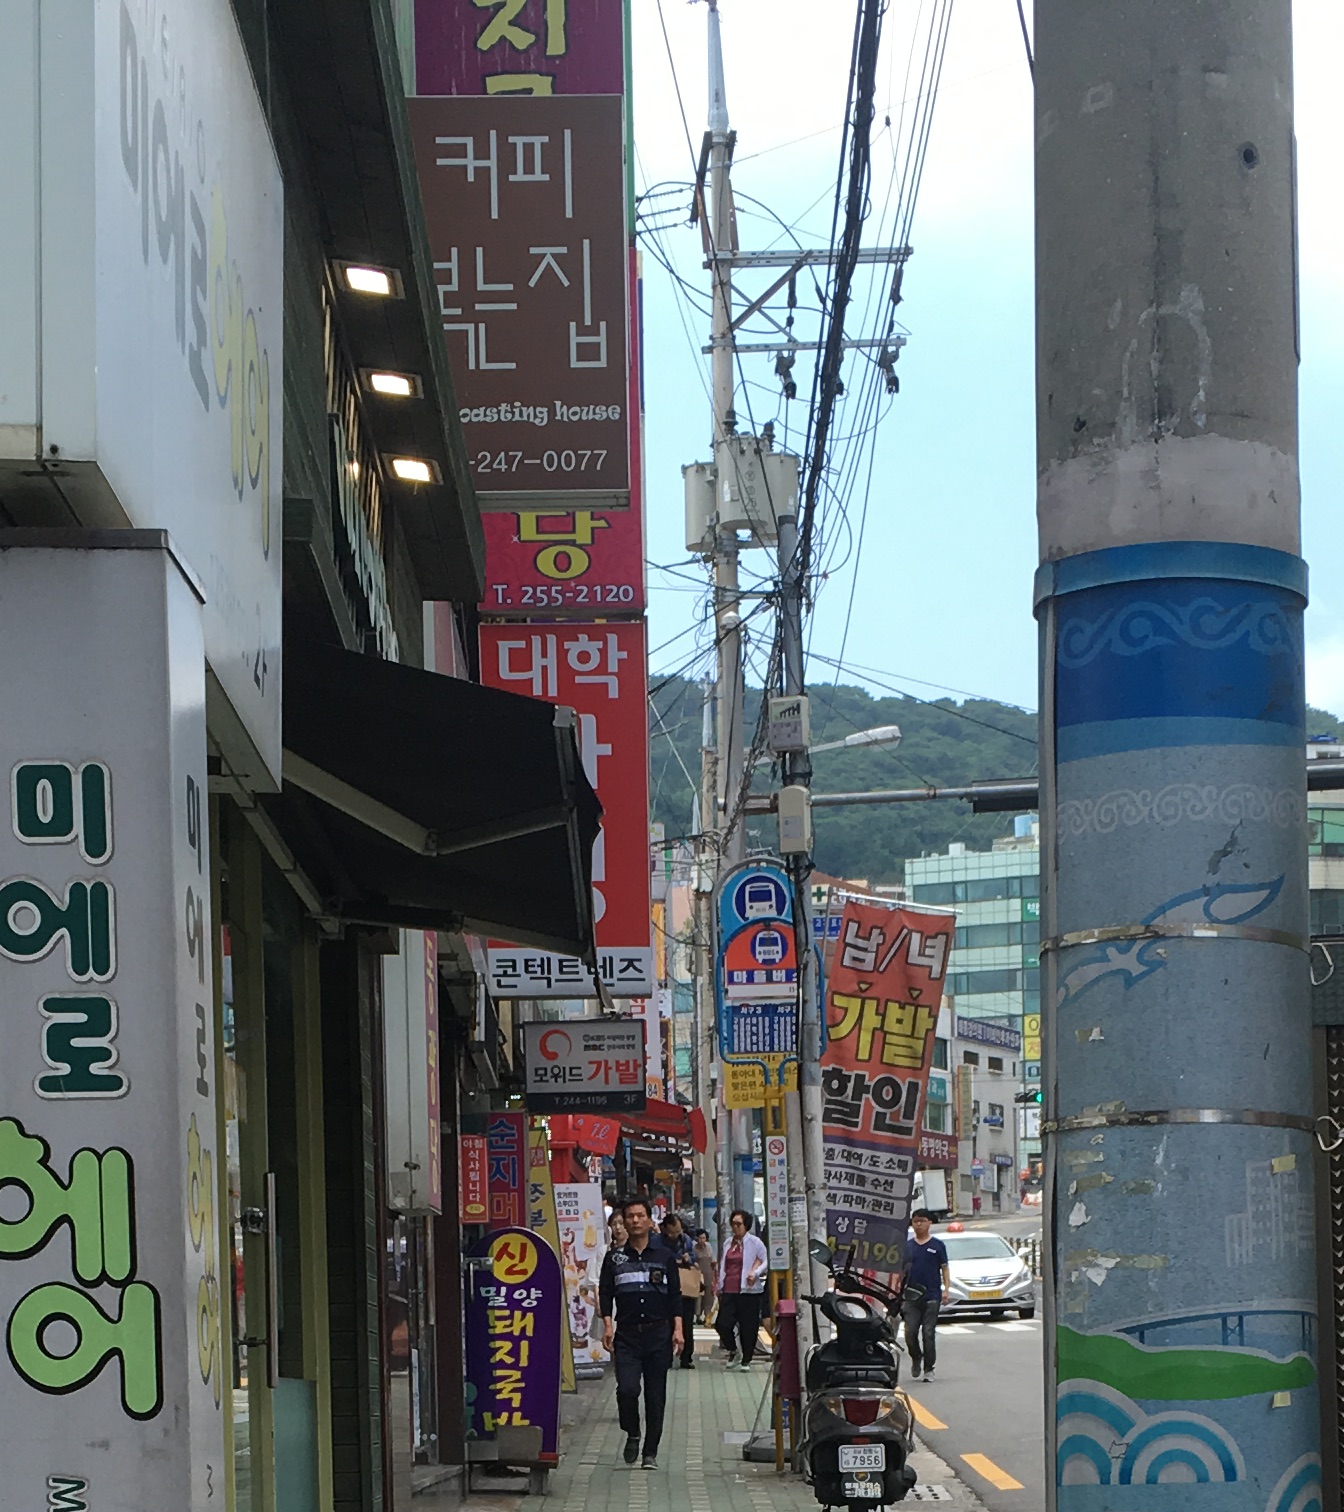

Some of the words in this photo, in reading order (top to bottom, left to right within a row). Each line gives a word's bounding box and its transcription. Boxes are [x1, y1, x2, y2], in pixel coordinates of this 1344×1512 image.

[435, 129, 573, 219] 커피
[555, 400, 622, 422] house
[493, 585, 512, 604] T.
[521, 584, 635, 606] 255-2120
[497, 633, 628, 699] 대학
[841, 920, 950, 981] 남/녀
[827, 991, 936, 1071] 가발
[587, 1058, 642, 1085] 가발
[821, 1066, 921, 1139] 할인
[494, 1242, 528, 1276] 신
[480, 1286, 543, 1308] 밀양
[852, 1455, 881, 1466] 7956
